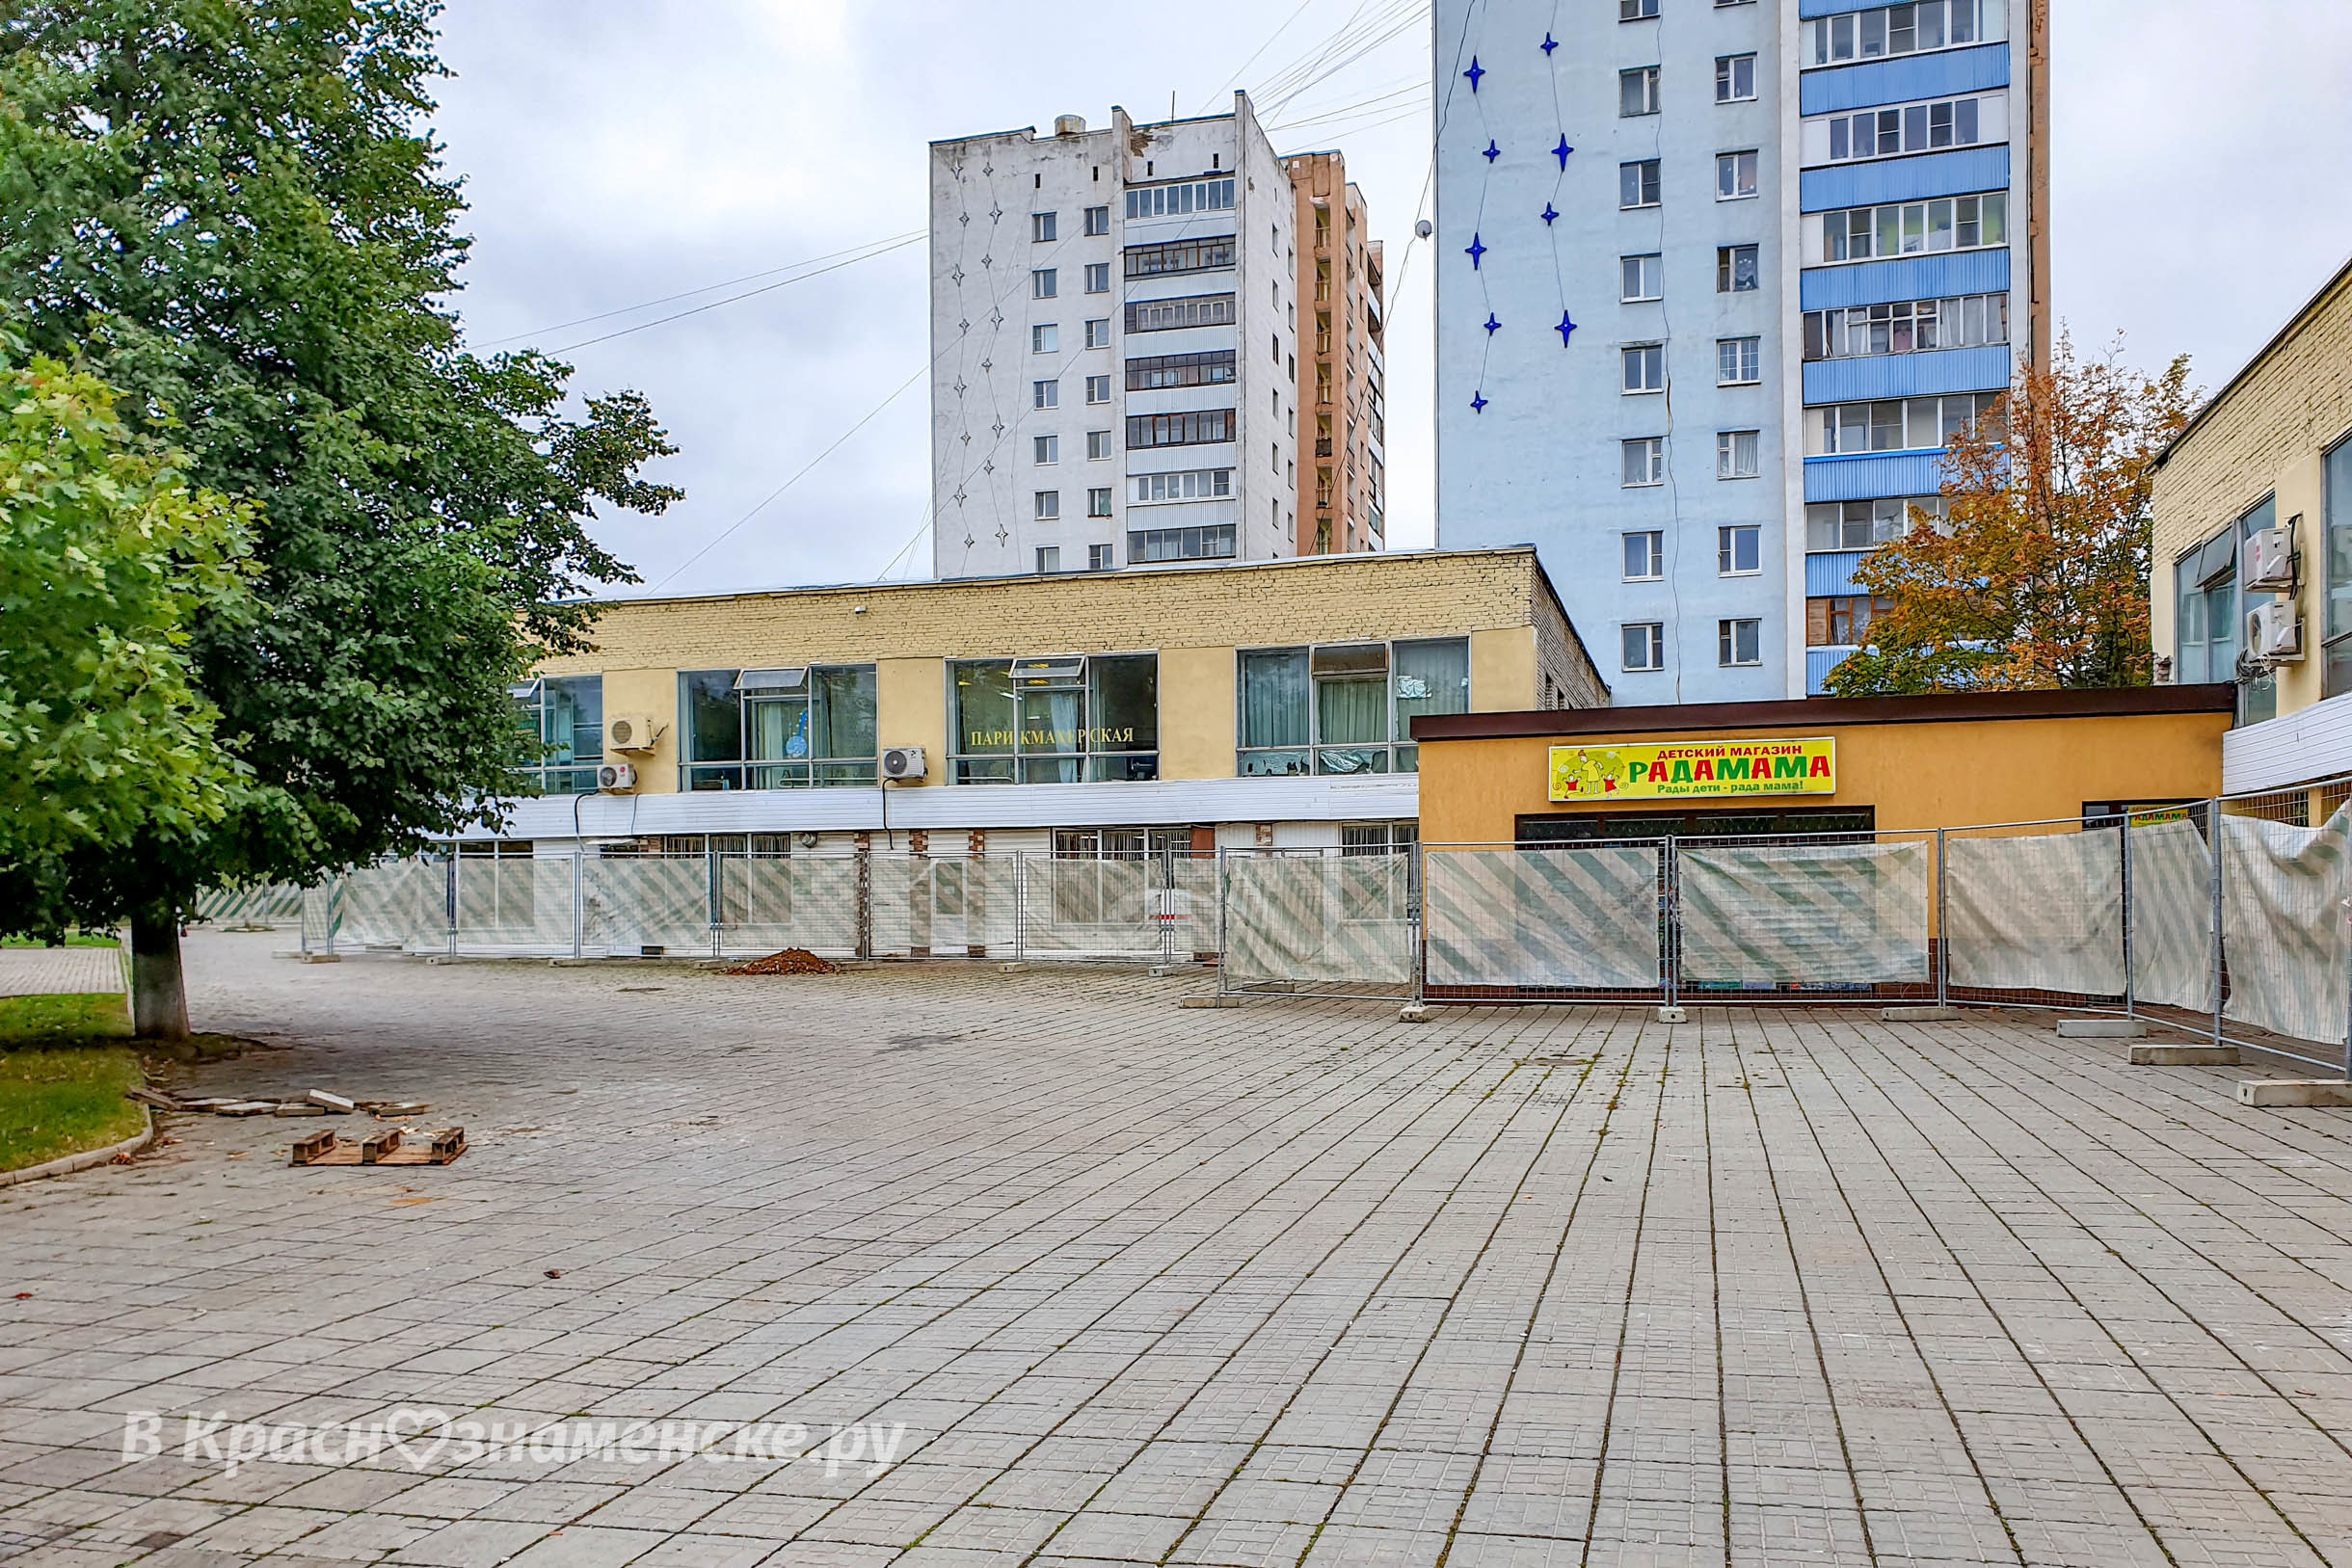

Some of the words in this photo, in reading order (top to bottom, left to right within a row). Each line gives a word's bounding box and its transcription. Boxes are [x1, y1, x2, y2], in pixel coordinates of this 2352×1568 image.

[1657, 745, 1725, 760] ДЕТСКИЙ
[1729, 745, 1803, 757] МАГАЗИН
[1629, 756, 1831, 784] РАДАМАМА
[1657, 784, 1690, 794] Рады
[1693, 784, 1721, 793] дети
[1730, 784, 1760, 793] рада
[1763, 780, 1804, 790] мама!
[2133, 812, 2187, 821] АДАМАМА
